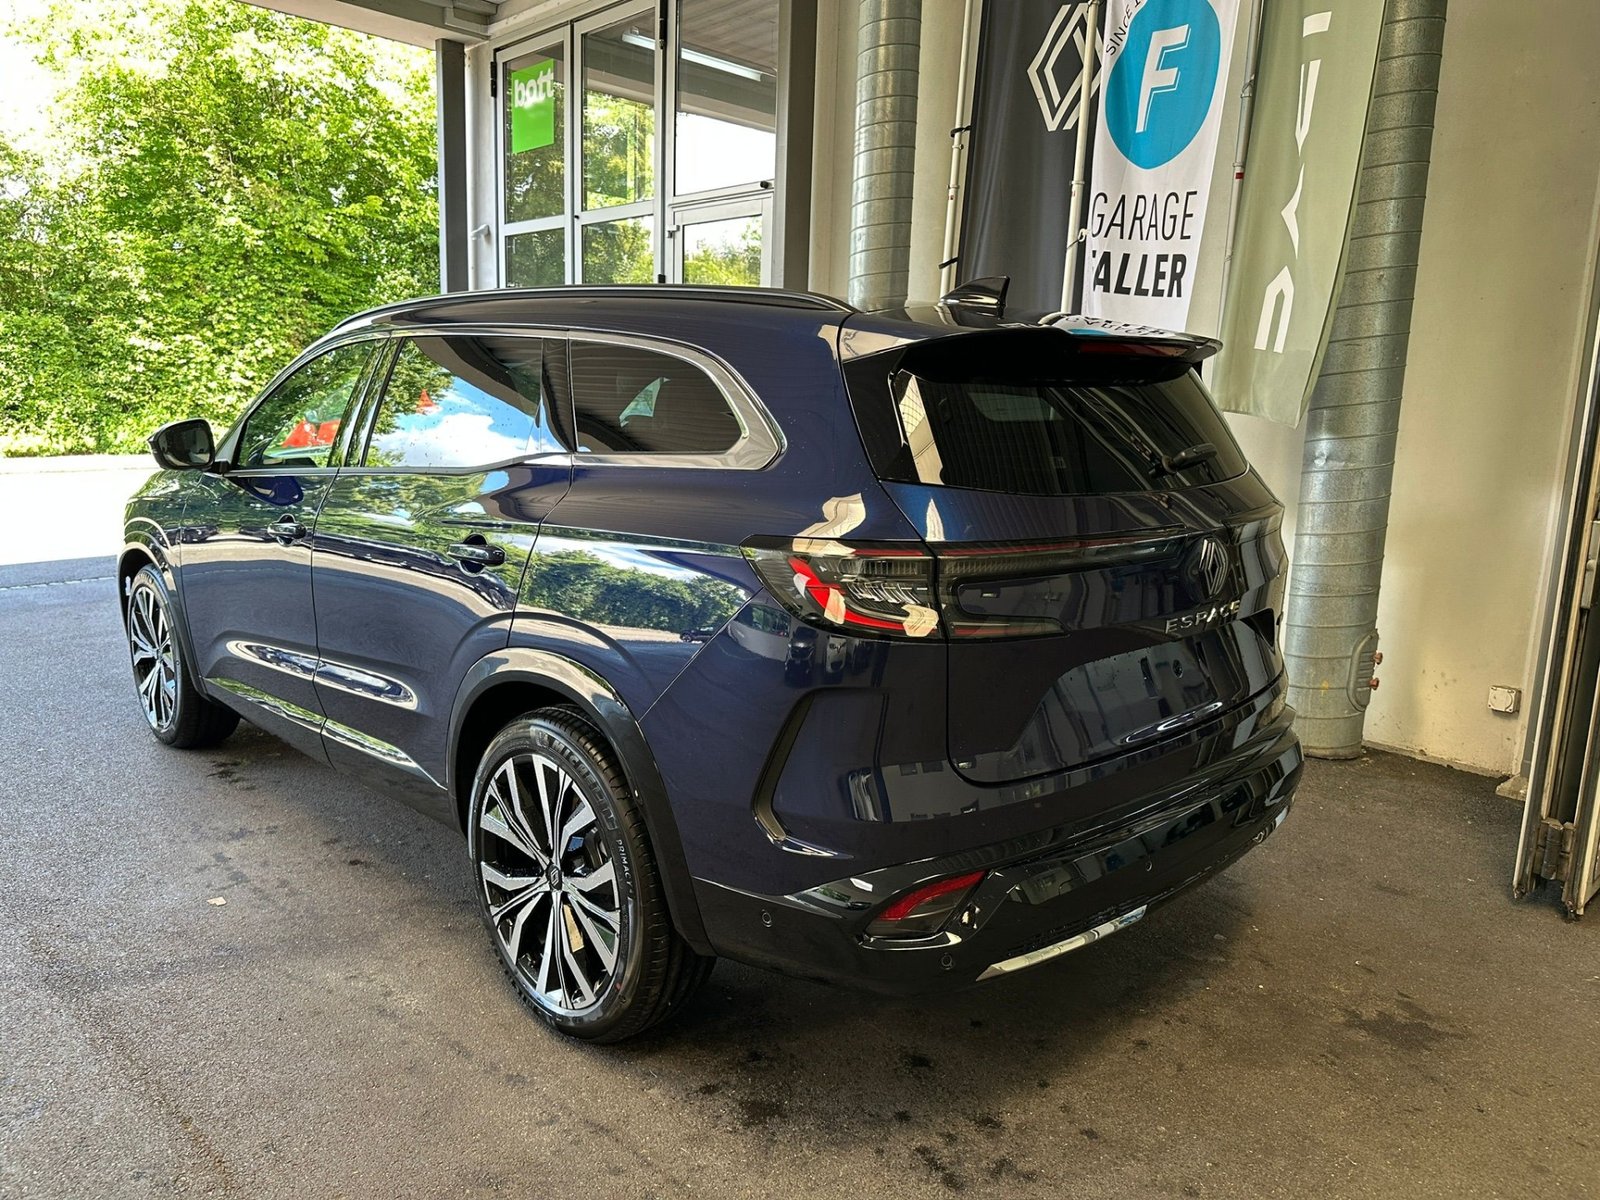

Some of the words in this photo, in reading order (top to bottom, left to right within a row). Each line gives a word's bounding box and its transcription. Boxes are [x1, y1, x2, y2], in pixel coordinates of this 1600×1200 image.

[1106, 4, 1133, 56] SINCE
[1135, 23, 1191, 134] F
[1091, 190, 1198, 241] GARAGE
[1092, 250, 1187, 298] ALLER
[1165, 599, 1241, 634] ESPACE
[616, 839, 633, 888] PRIMACY
